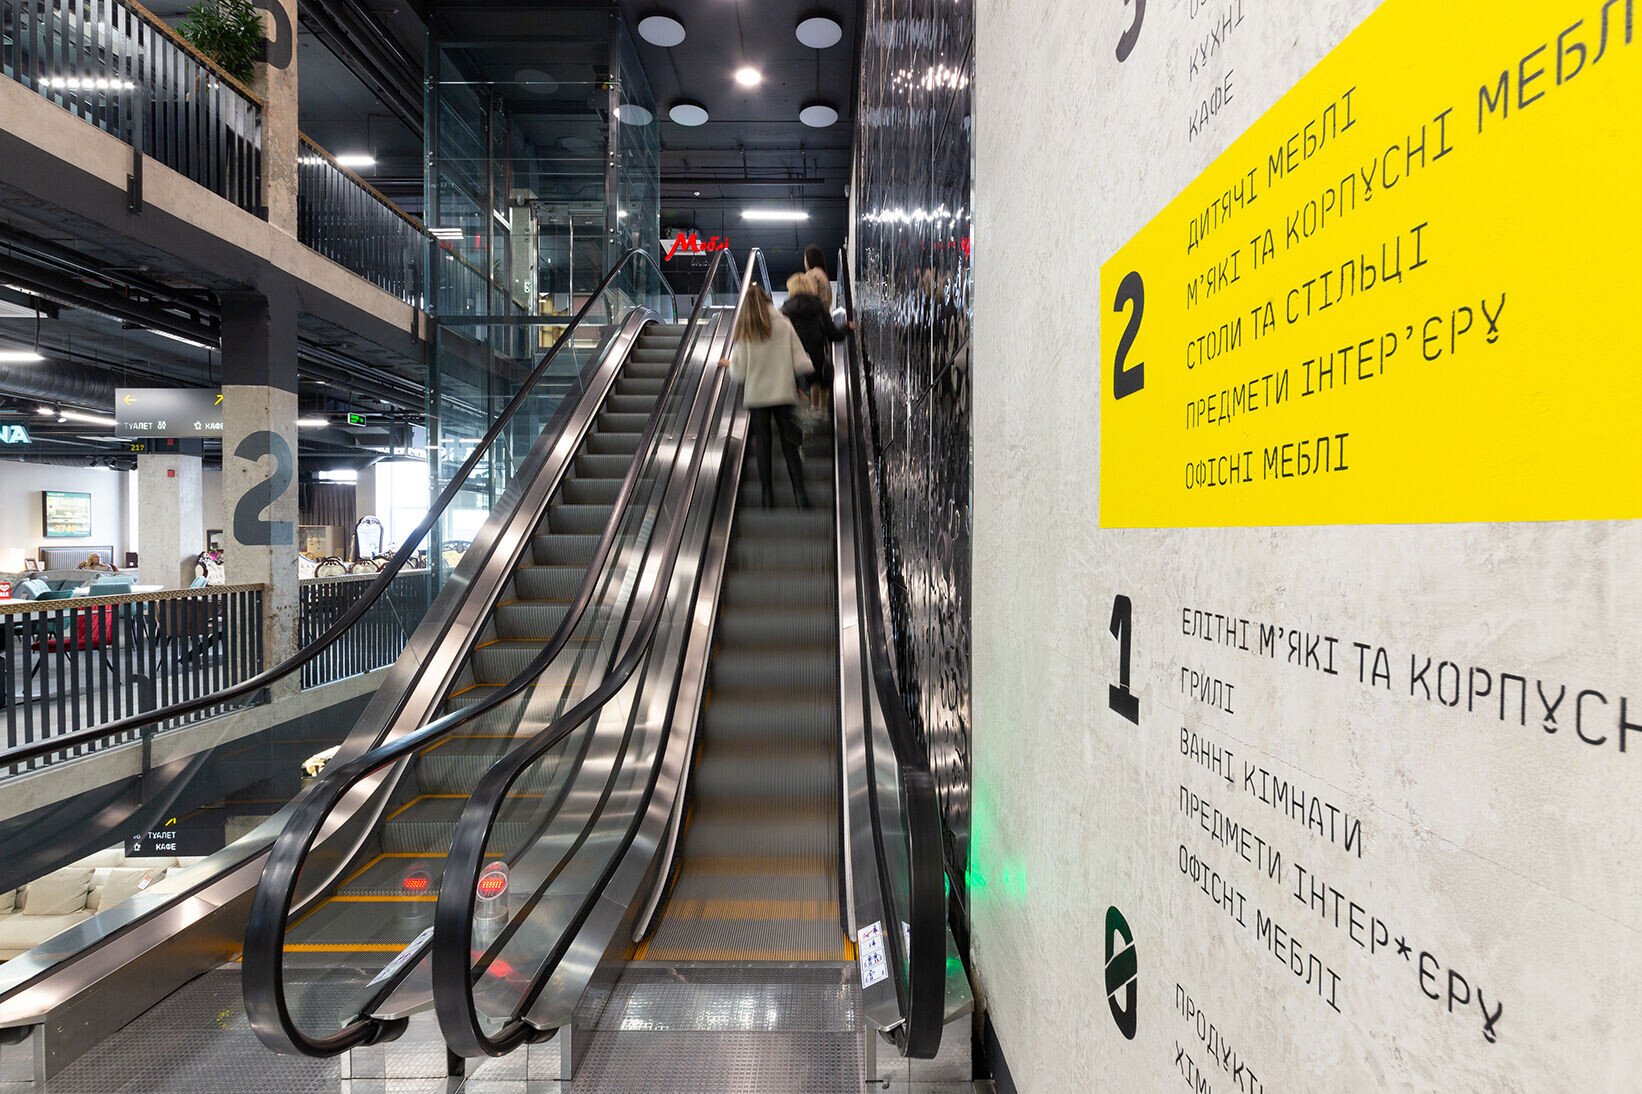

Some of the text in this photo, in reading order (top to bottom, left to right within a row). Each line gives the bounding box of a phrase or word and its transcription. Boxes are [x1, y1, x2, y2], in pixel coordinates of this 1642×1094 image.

[1189, 69, 1234, 142] КАФЕ
[1188, 87, 1356, 255] ДИТЯЧІ МЕБЛІ
[1250, 228, 1275, 270] ТА
[1287, 107, 1453, 250] КОРПУСНІ
[664, 232, 729, 262] Меблі
[1113, 271, 1145, 400] 2
[1187, 222, 1428, 370] СТОЛИ ТА СТІЛЬЦІ
[124, 422, 153, 431] ТУАЛЕТ
[1186, 369, 1289, 429] ПРЕДМЕТИ
[130, 444, 145, 452] 217
[233, 430, 294, 546] 2
[1185, 433, 1349, 490] ОФІСНІ МЕБЛІ
[1109, 594, 1139, 726] 1
[1183, 607, 1249, 651] ЕЛІТНІ
[1353, 642, 1391, 690] ТА
[1181, 667, 1234, 715] ГРИЛІ
[1181, 727, 1361, 858] ВАННІ КІМНАТИ
[147, 831, 177, 840] ТУАЛЕТ
[155, 843, 177, 851] КАФЕ
[1180, 785, 1281, 884] ПРЕДМЕТИ
[1179, 844, 1341, 1014] ОФІСНІ МЕБЛІ
[1175, 983, 1264, 1094] ПРОДУКТ
[1175, 1040, 1212, 1094] ХІМ
